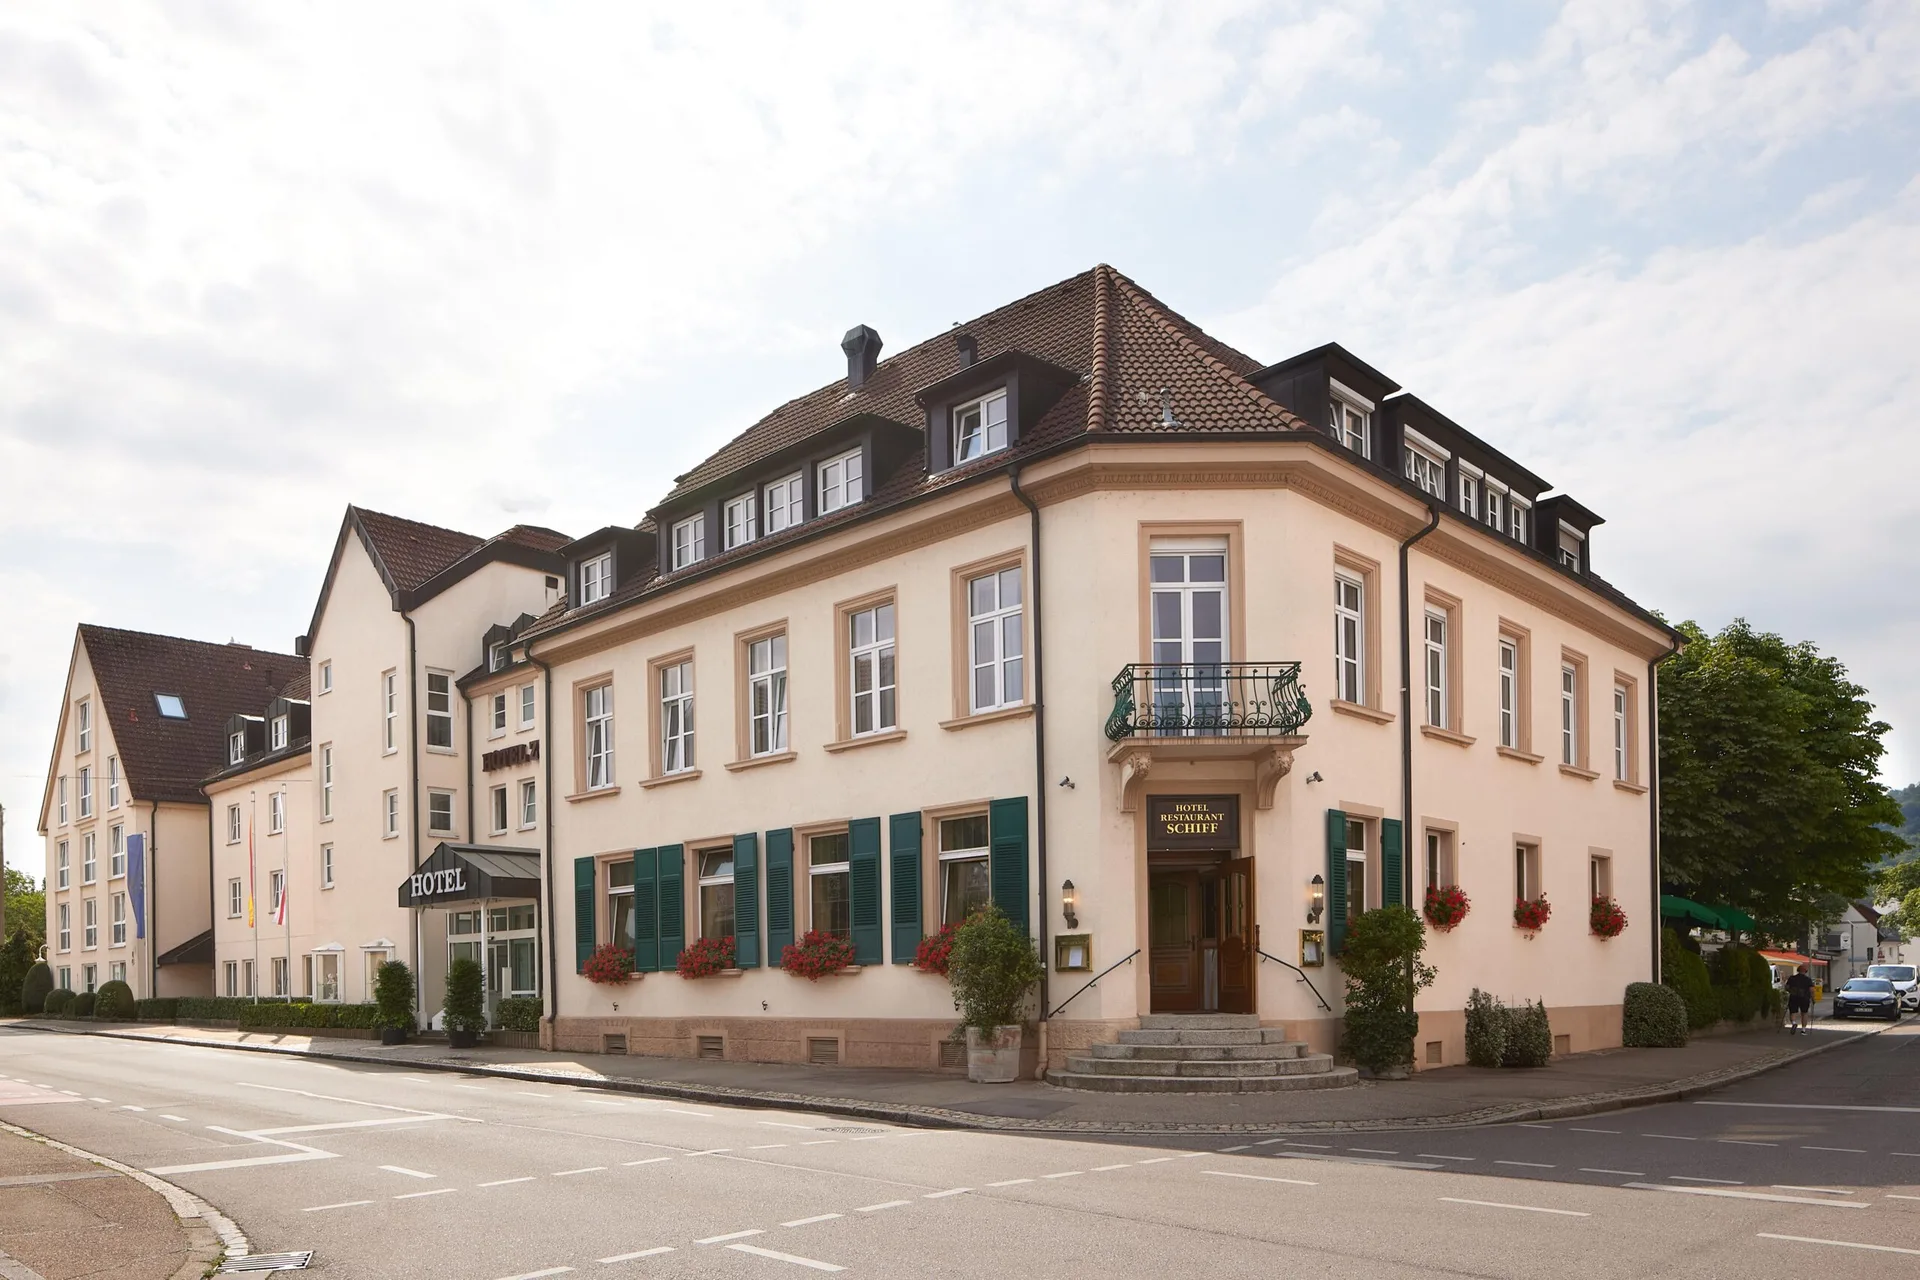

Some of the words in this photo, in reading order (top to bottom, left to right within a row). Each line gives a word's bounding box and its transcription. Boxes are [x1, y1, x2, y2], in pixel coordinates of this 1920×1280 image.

[1176, 804, 1209, 812] HOTEL
[1160, 813, 1224, 821] RESTAURANT
[1166, 823, 1218, 834] SCHIFF
[410, 868, 466, 897] HOTEL
